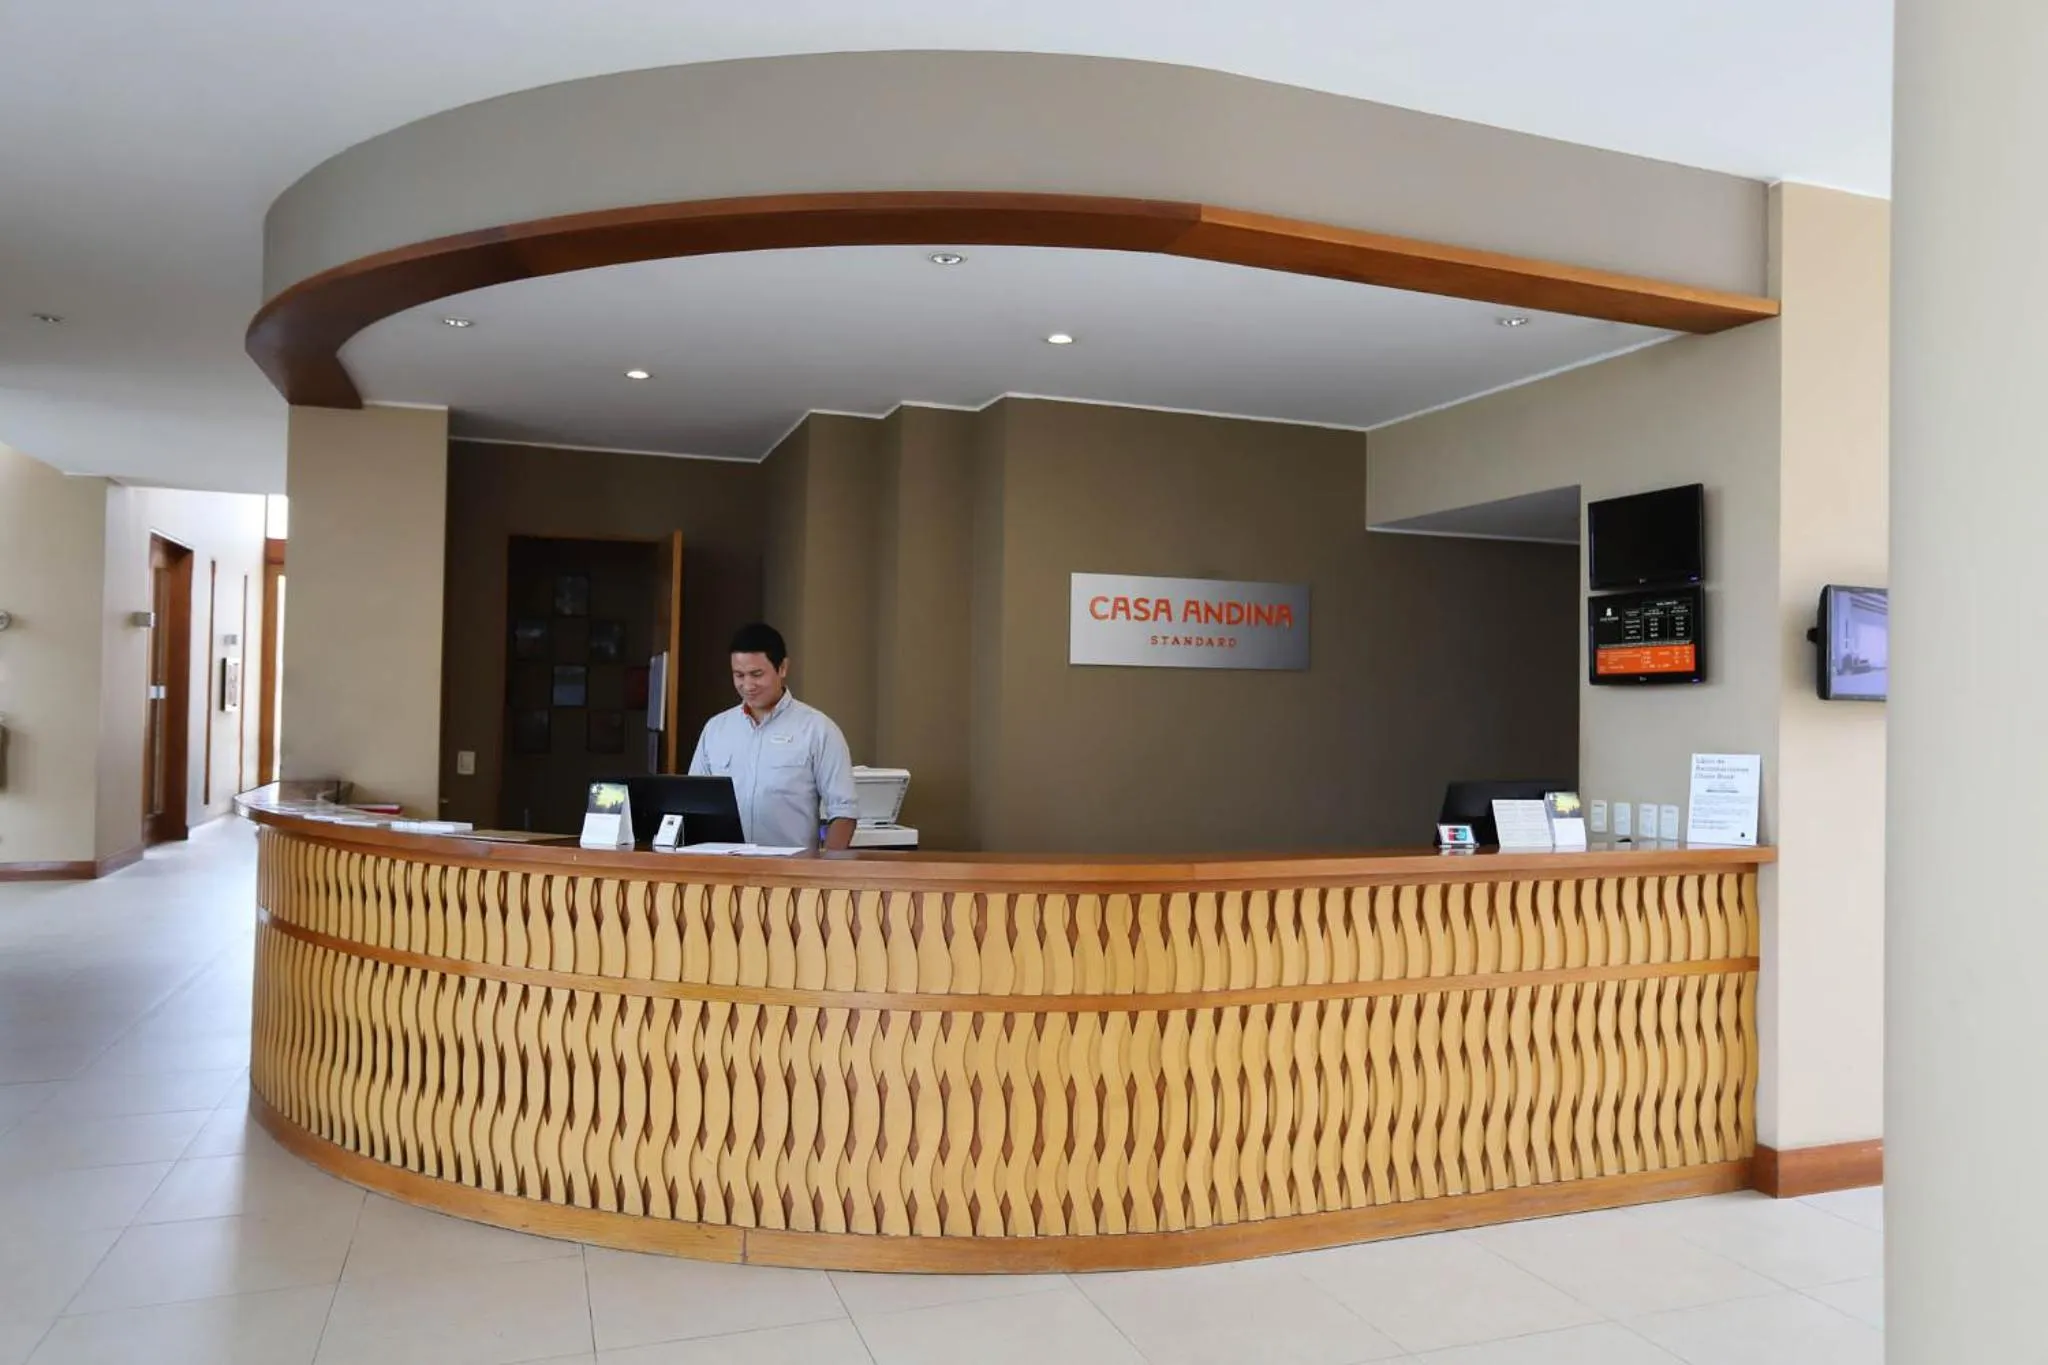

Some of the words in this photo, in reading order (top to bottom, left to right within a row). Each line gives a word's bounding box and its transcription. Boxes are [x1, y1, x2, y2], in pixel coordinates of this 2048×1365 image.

[1089, 596, 1172, 622] CASA
[1182, 600, 1293, 628] ANDINA
[1150, 635, 1237, 648] STANDARD
